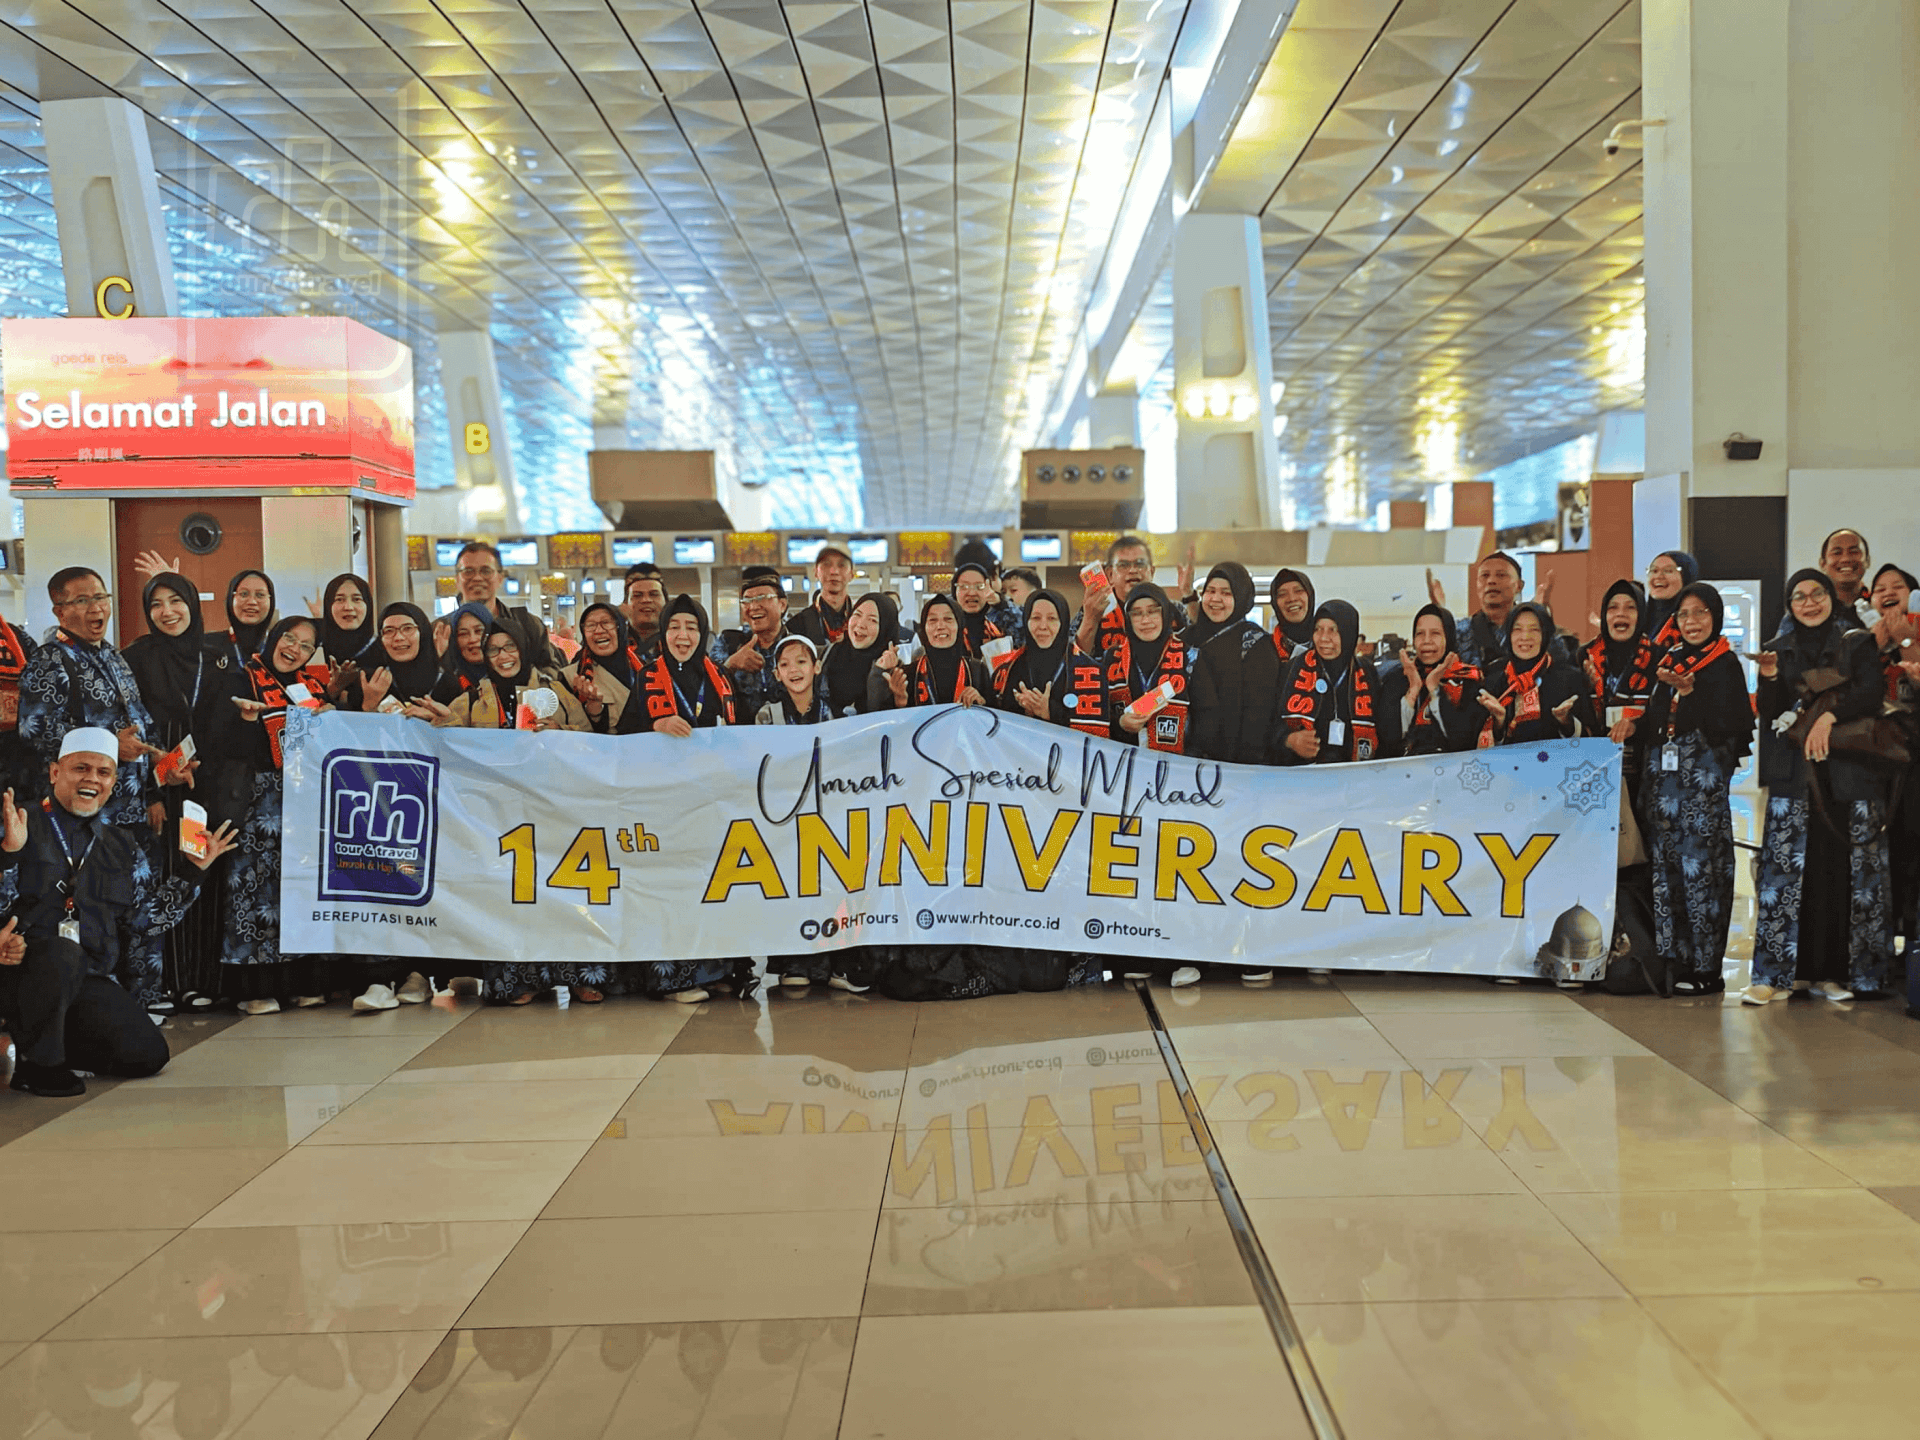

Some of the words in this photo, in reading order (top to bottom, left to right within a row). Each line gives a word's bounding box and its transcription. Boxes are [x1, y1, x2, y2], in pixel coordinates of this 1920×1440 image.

[96, 276, 135, 319] C
[16, 390, 196, 429] Selamat
[211, 388, 326, 429] Jalan
[465, 423, 490, 454] B
[1074, 666, 1102, 715] RH
[1157, 718, 1177, 734] rh
[757, 735, 904, 826] Umrah
[912, 704, 1063, 800] Spesial
[1080, 736, 1225, 835] Milad
[334, 781, 425, 844] rh
[335, 842, 363, 856] tour
[364, 844, 375, 857] &
[376, 845, 418, 860] travel
[499, 823, 660, 905] 14th
[701, 799, 1561, 919] ANNIVERSARY
[312, 911, 402, 924] BEREPUTASI
[405, 915, 438, 927] BAIK
[840, 912, 899, 930] RHTours
[936, 911, 1060, 931] www.rhtour.co.id
